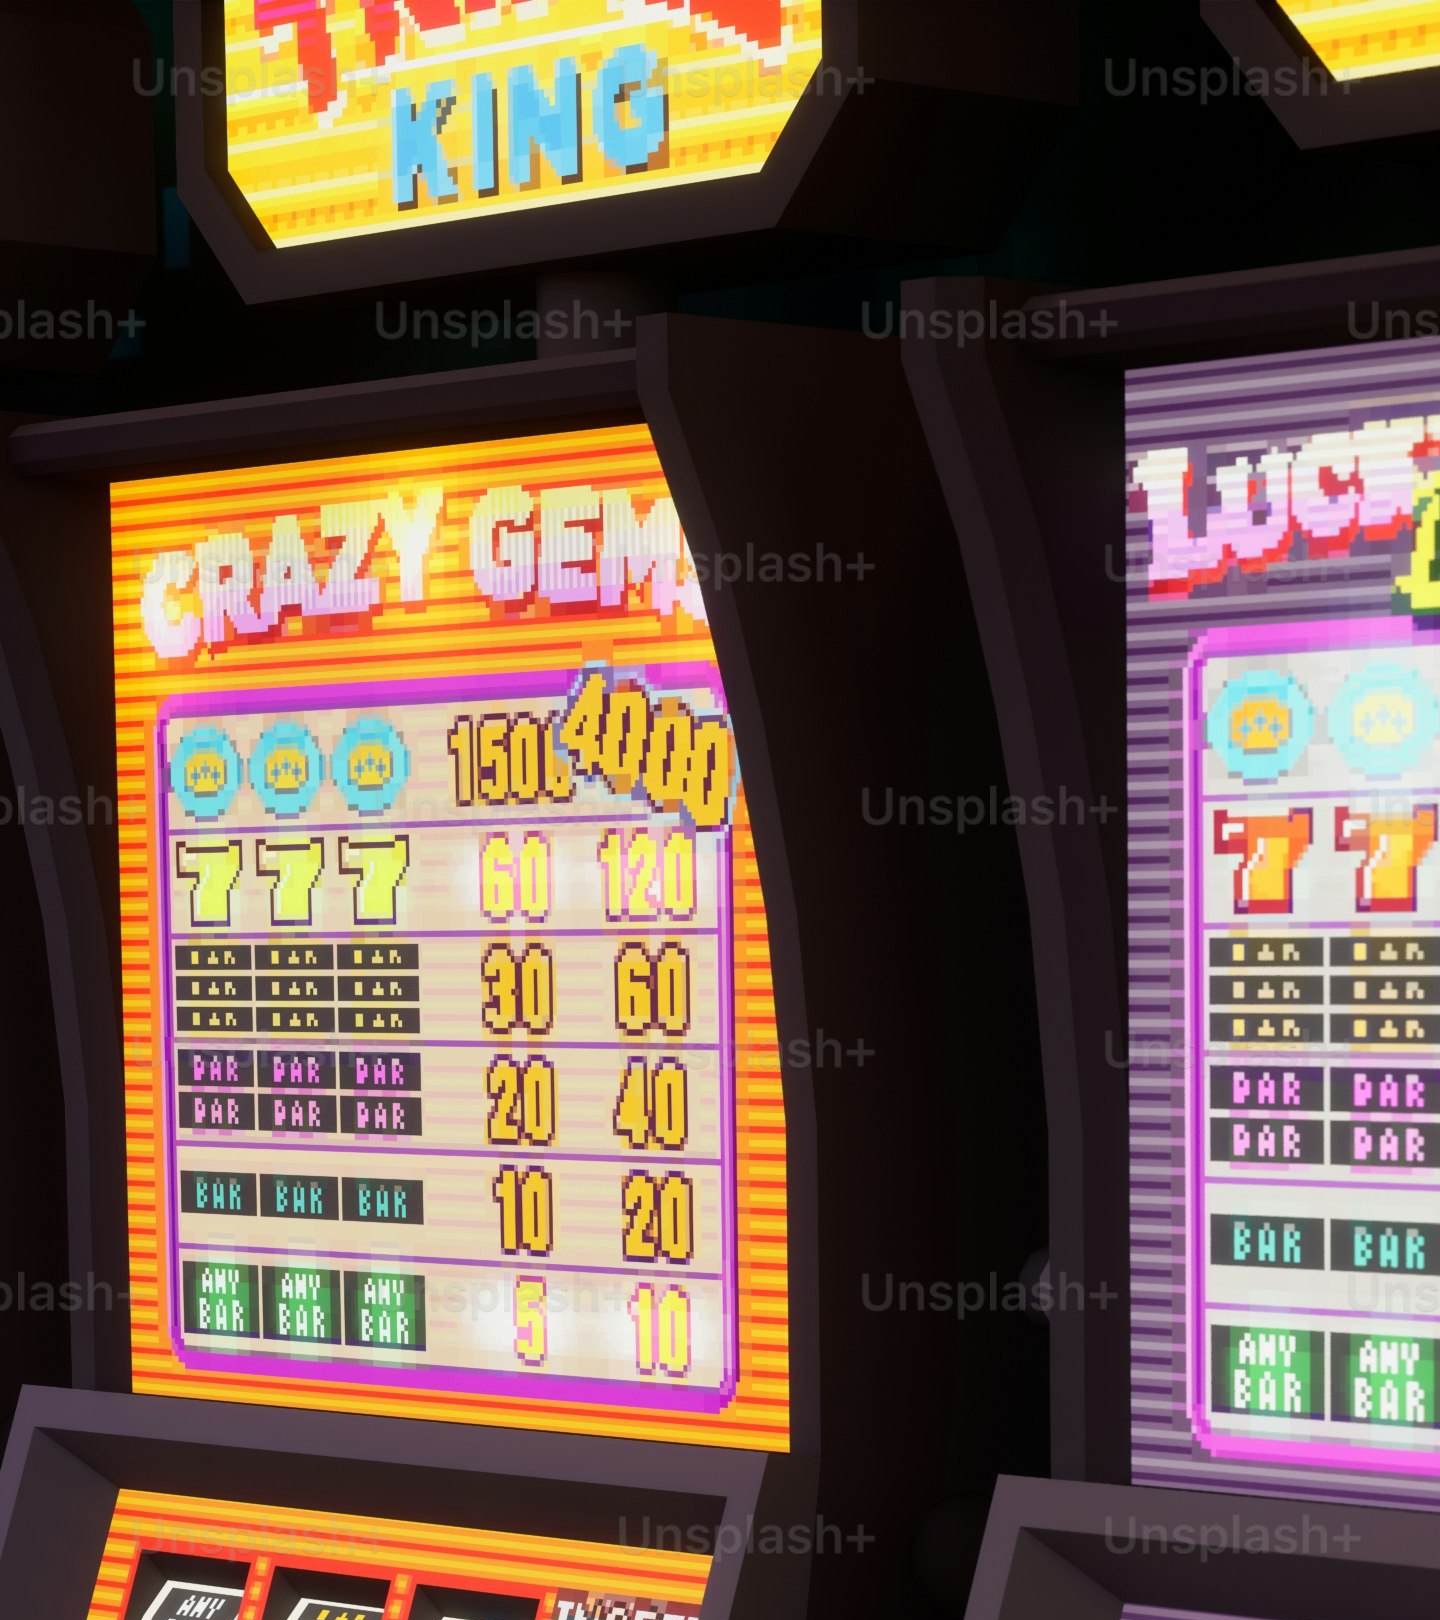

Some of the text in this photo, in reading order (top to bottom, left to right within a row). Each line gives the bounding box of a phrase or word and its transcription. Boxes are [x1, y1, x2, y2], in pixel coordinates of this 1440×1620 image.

[392, 44, 669, 211] KING
[141, 486, 444, 658] CRAZY
[176, 828, 698, 926] 7 7 7 60 120
[1213, 806, 1313, 913] 7
[1334, 804, 1438, 912] 7
[481, 942, 556, 1034] 30
[614, 942, 690, 1036] 60
[486, 1054, 688, 1150] 20 40
[1234, 1221, 1300, 1263] BAR
[1233, 1371, 1301, 1414] BAR
[176, 1594, 225, 1619] ANY
